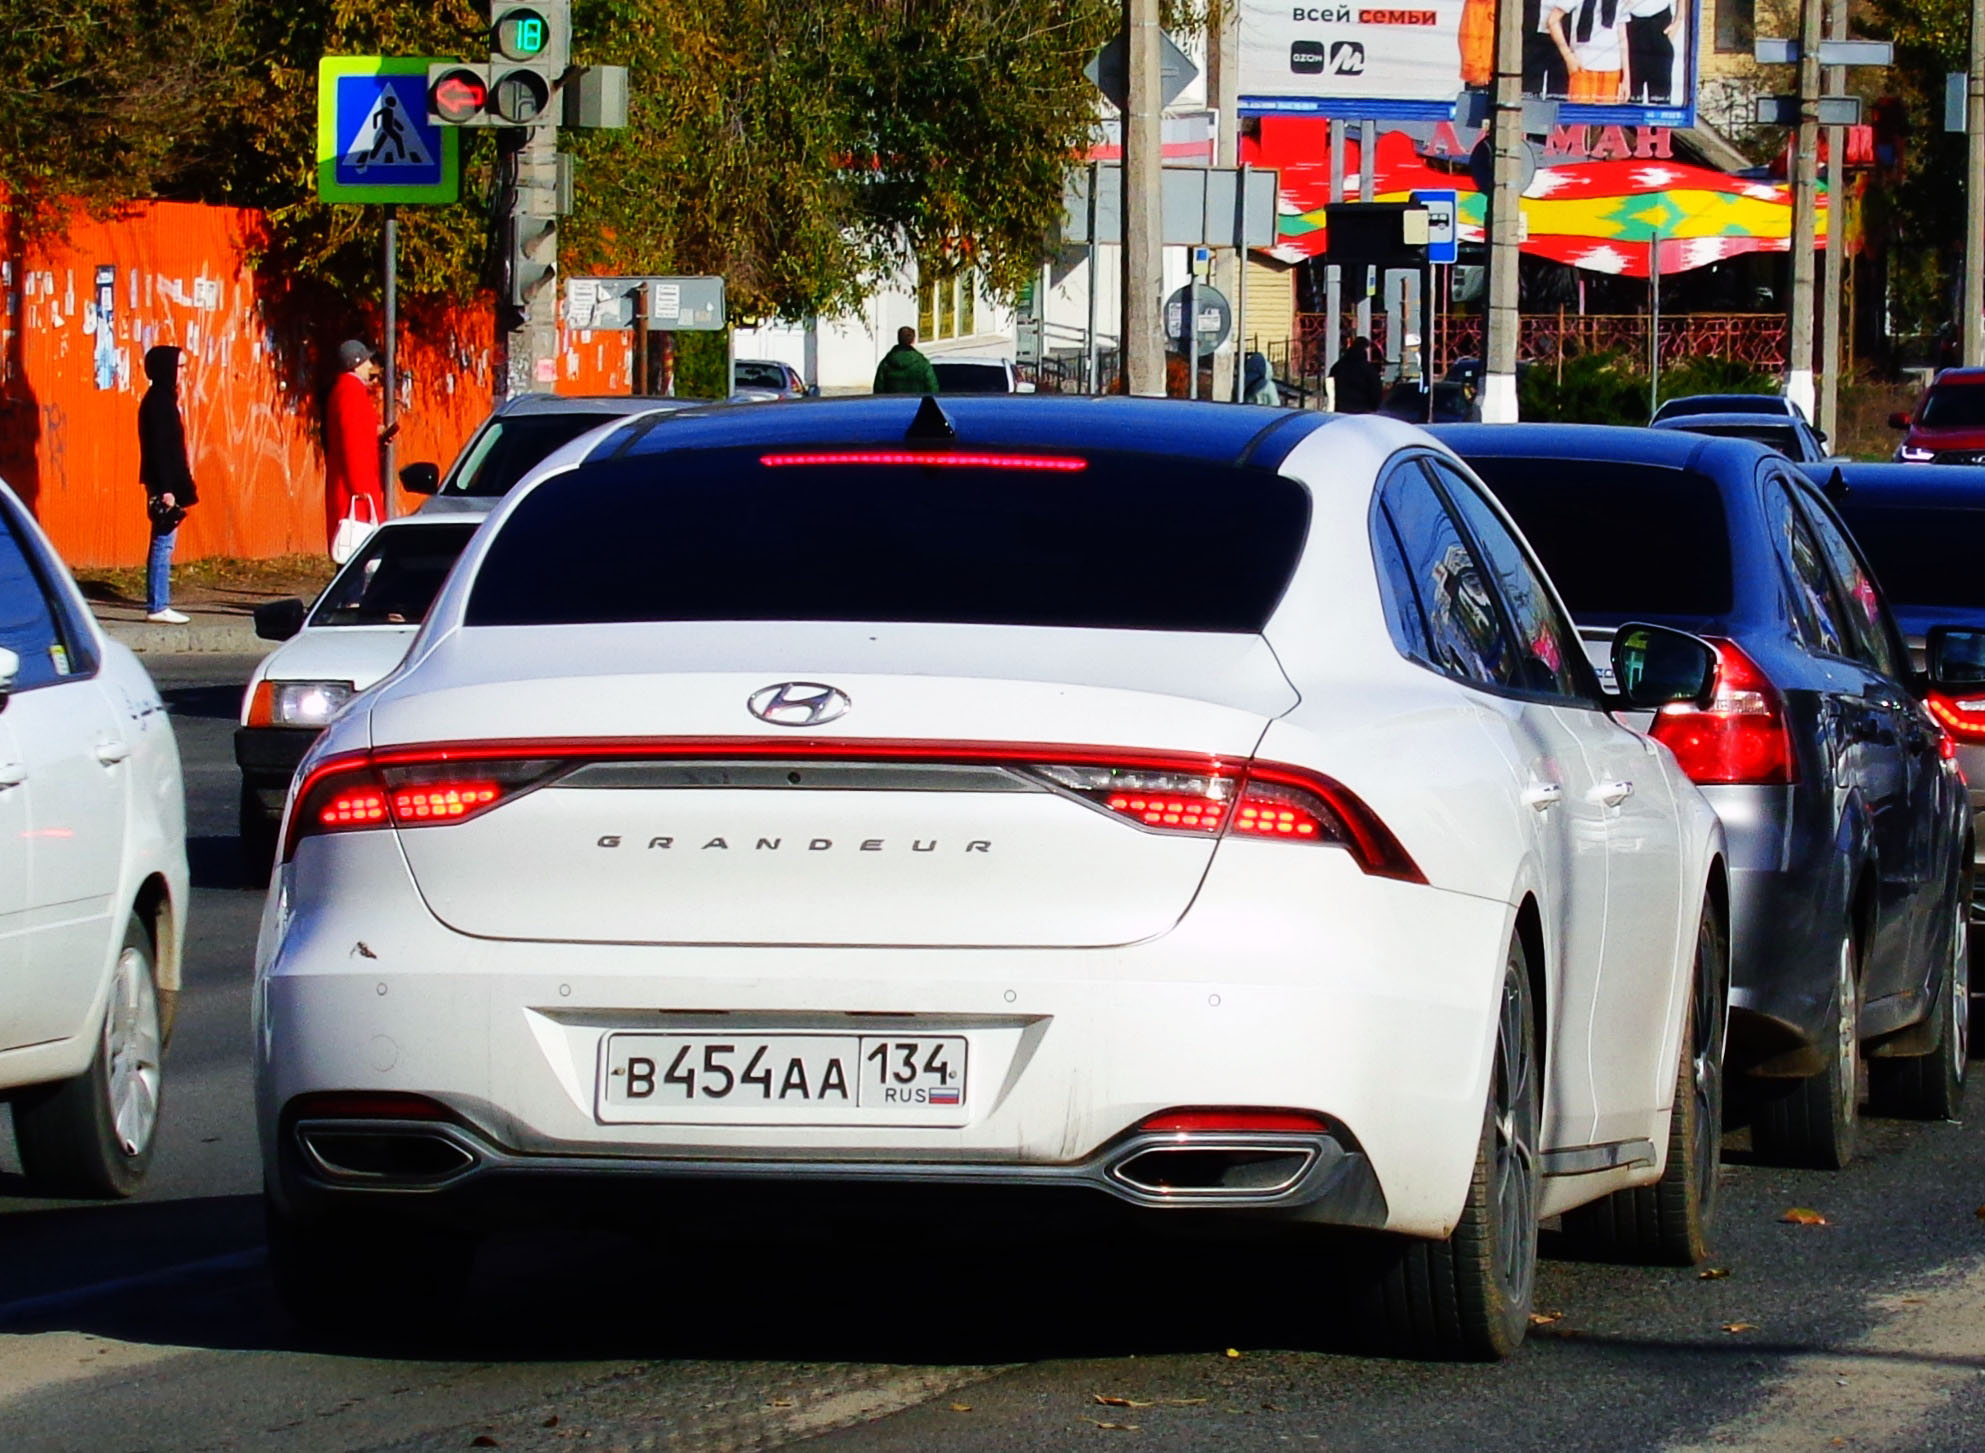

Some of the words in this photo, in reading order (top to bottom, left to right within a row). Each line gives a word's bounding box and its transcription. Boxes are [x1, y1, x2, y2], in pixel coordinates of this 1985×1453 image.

[1293, 4, 1351, 22] всей
[1358, 9, 1437, 26] семьи
[516, 18, 542, 51] 18
[597, 835, 992, 853] GRANDEUR
[867, 1043, 948, 1086] 134
[885, 1087, 926, 1104] RUS
